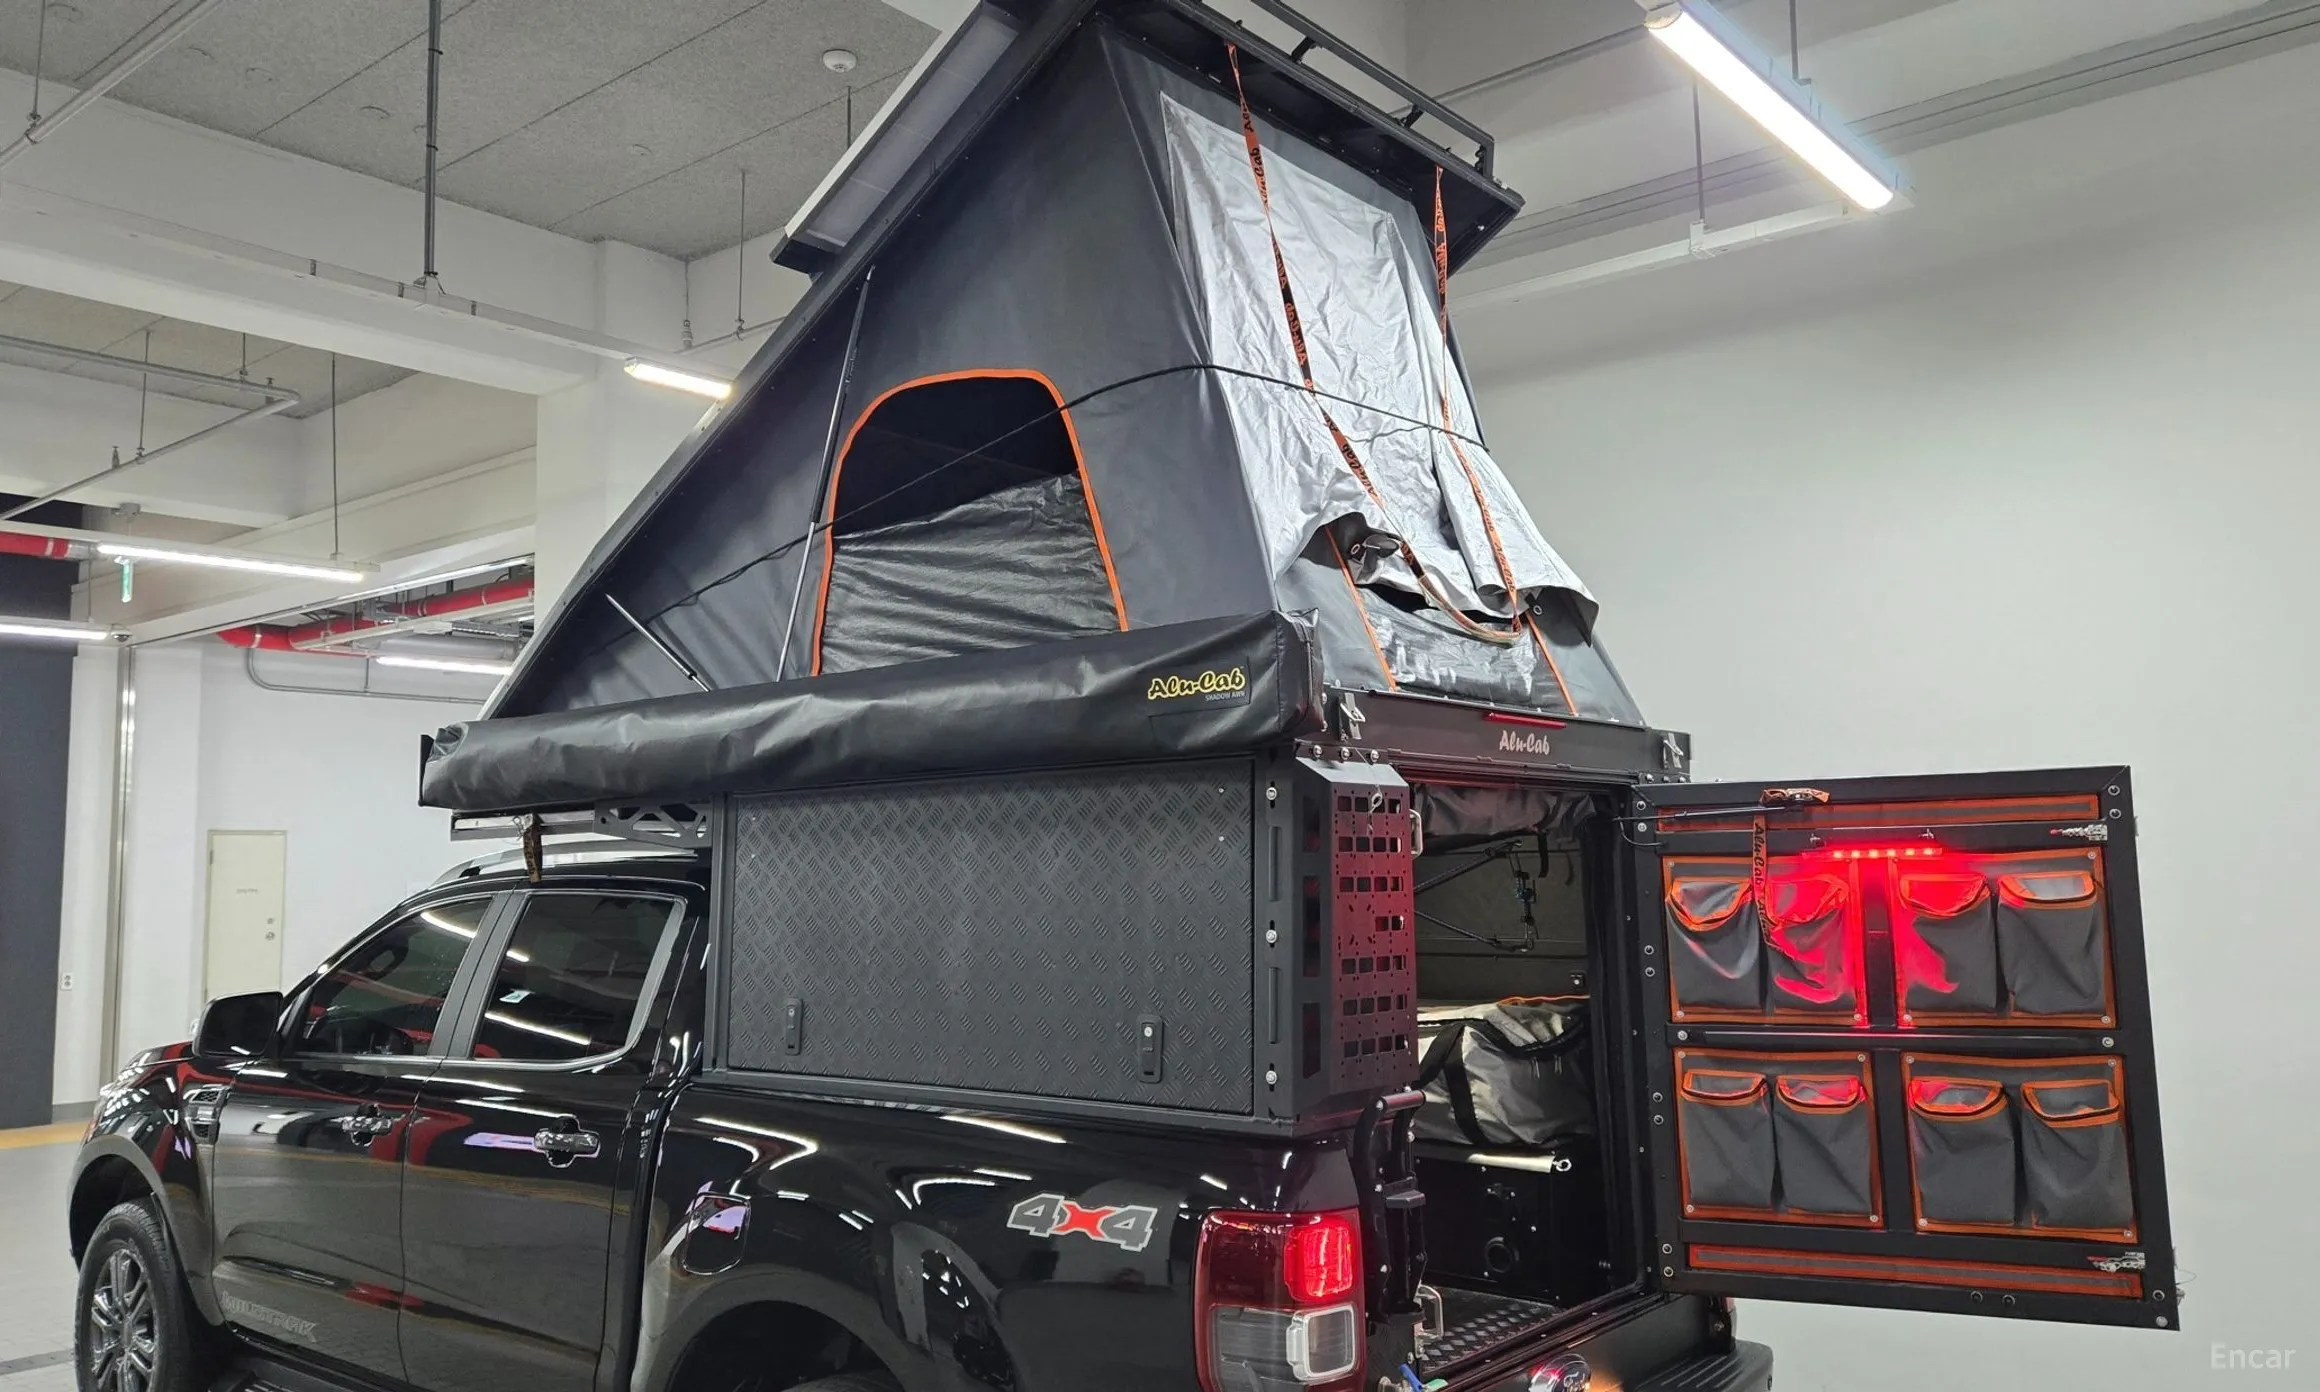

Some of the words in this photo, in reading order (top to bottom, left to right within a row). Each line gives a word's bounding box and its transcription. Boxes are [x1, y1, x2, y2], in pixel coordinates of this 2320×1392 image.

[1147, 667, 1246, 700] Alu-Cab
[1499, 729, 1550, 755] Alu-Cab
[1754, 822, 1765, 886] Alu-Cab
